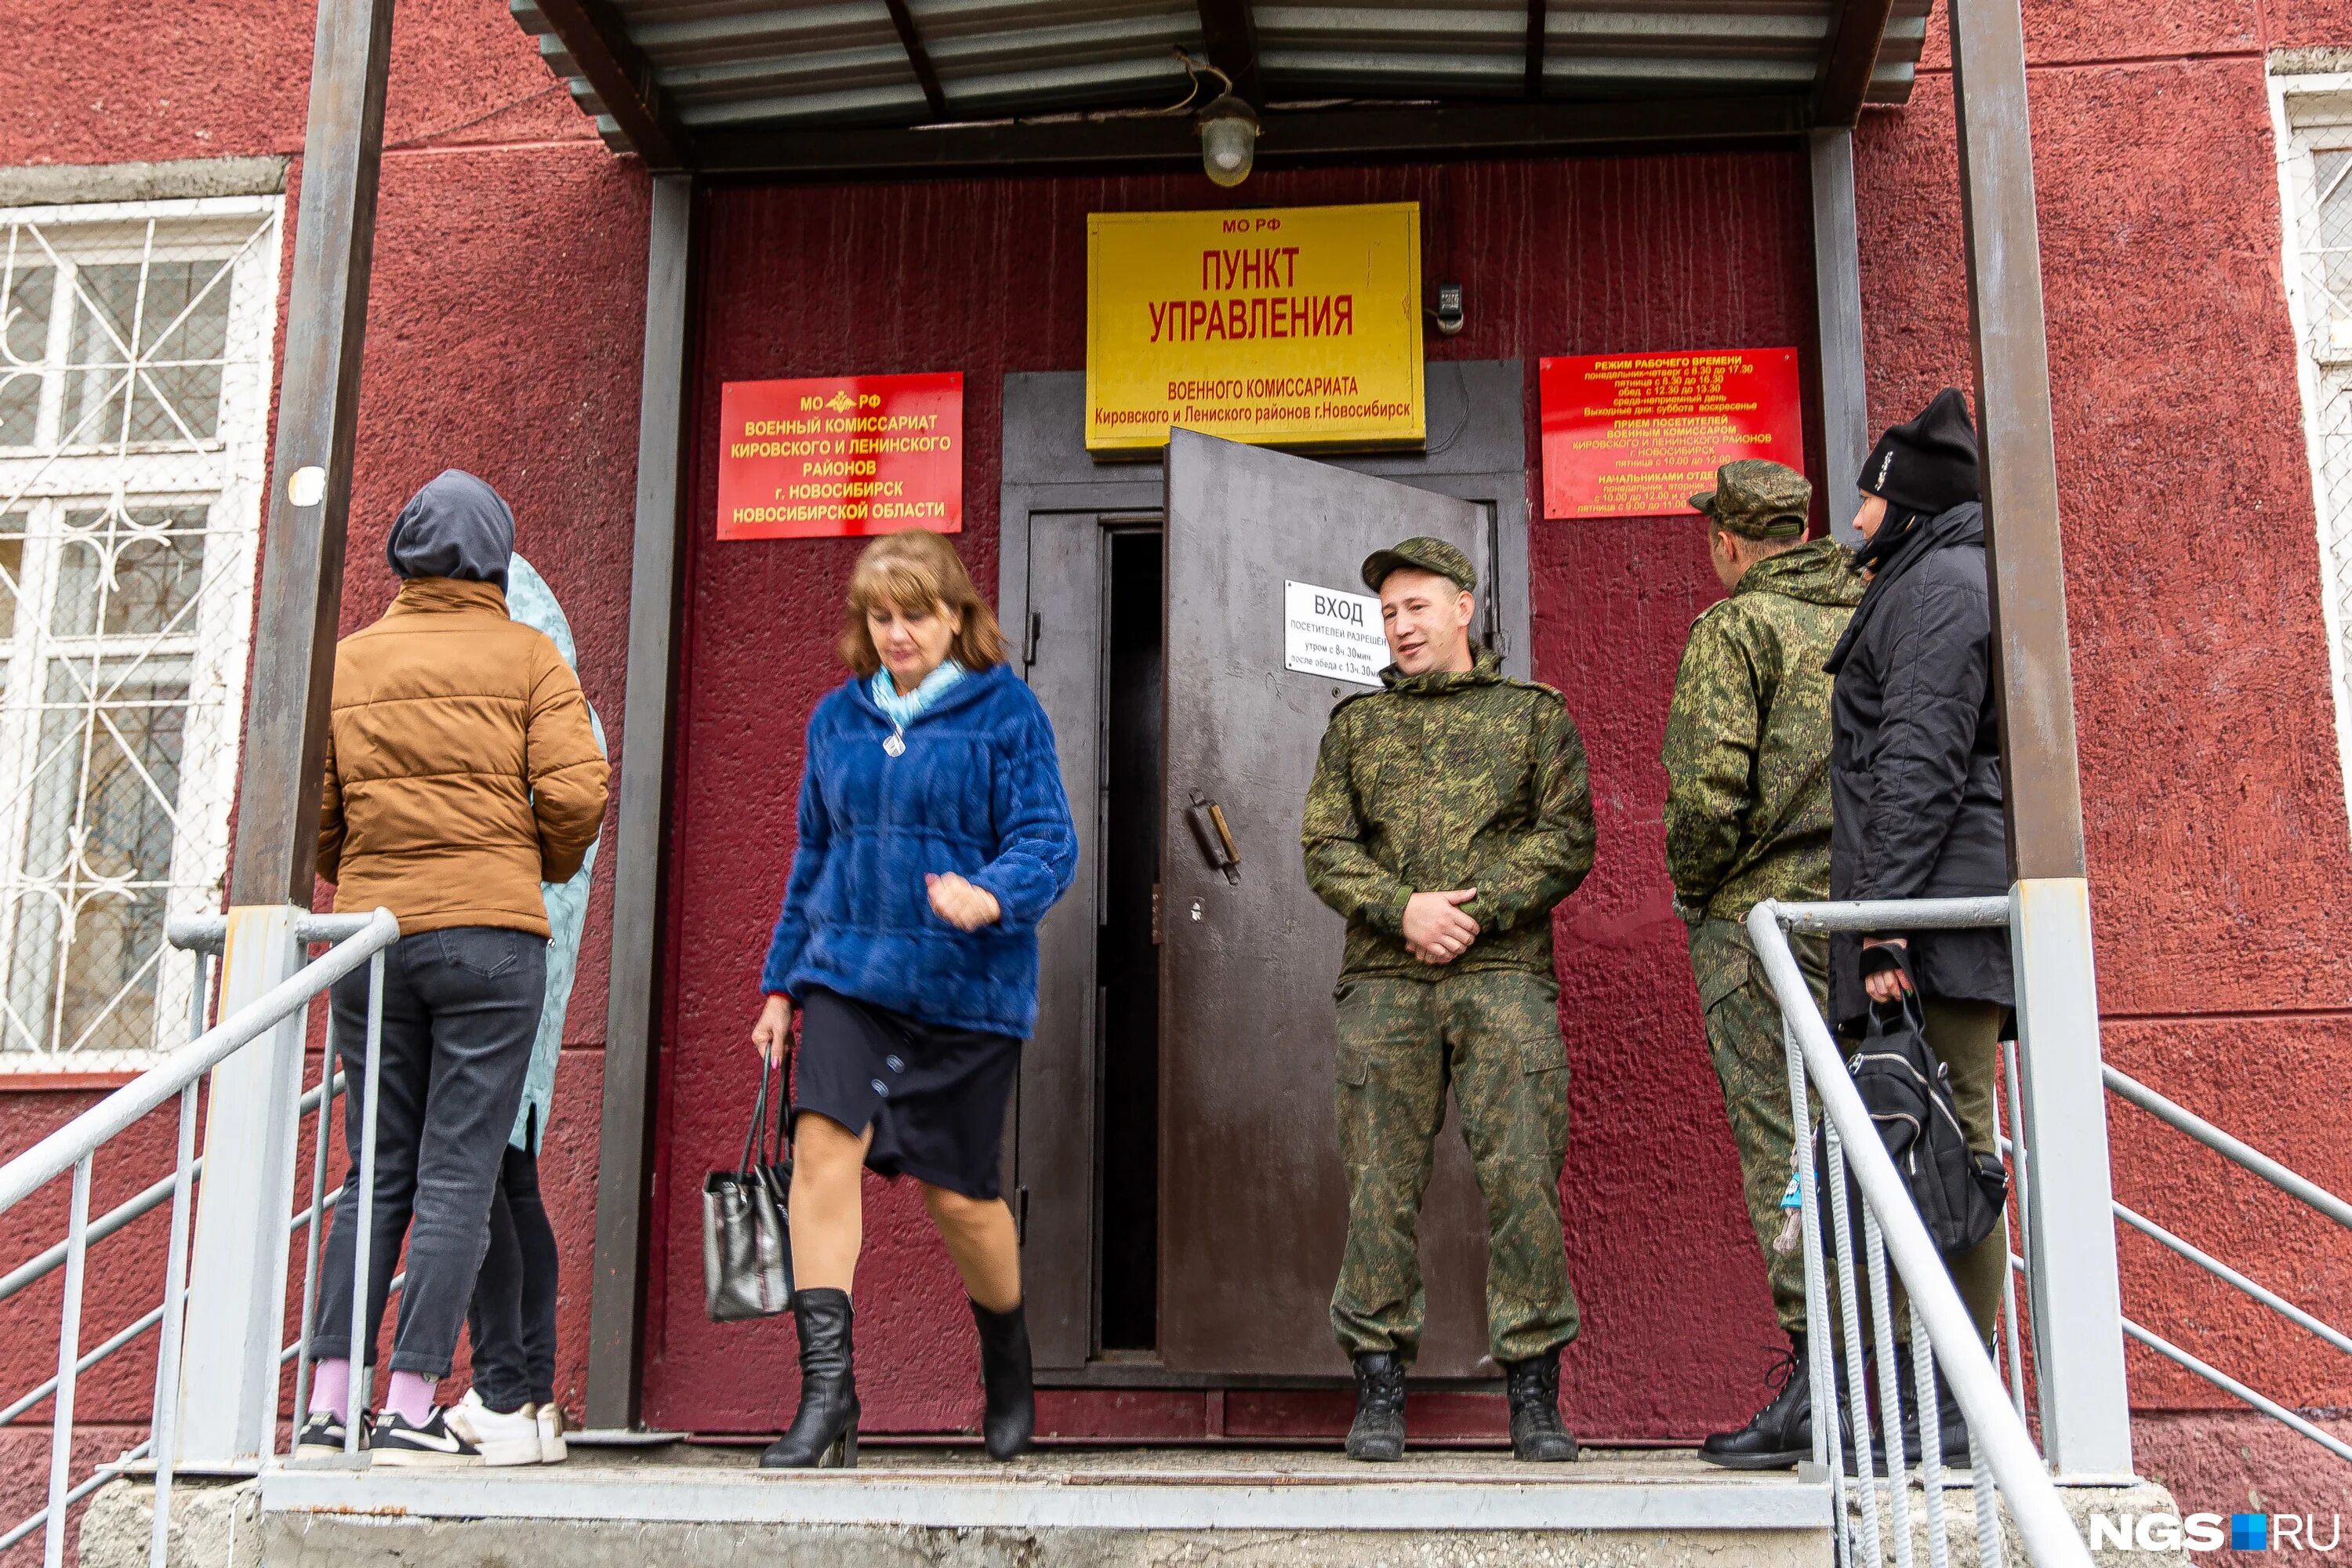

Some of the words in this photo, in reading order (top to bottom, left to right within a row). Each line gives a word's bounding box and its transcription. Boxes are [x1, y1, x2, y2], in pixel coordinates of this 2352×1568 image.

[1222, 220, 1249, 234] МО
[1256, 218, 1281, 232] РФ
[1203, 247, 1300, 291] ПУНКТ
[1149, 295, 1352, 343] УПРАВЛЕНИЯ
[1595, 361, 1632, 371] РЕЖИМ
[1635, 358, 1690, 369] РАБОЧЕГО
[1693, 356, 1742, 366] ВРЕМЕНИ
[1714, 367, 1725, 376] до
[1168, 379, 1243, 401] ВОЕННОГО
[1247, 376, 1358, 399] КОМИССАРИАТА
[1615, 379, 1652, 388] пятница
[1684, 376, 1696, 386] до
[1681, 386, 1693, 395] до
[800, 396, 823, 412] МО
[858, 394, 880, 409] РФ
[1704, 394, 1726, 404] день
[1095, 407, 1169, 427] Кировского
[1174, 412, 1180, 423] и
[1255, 403, 1310, 425] районов
[1584, 407, 1632, 417] Выходные
[1657, 403, 1693, 416] суббота
[1699, 402, 1757, 412] воскресенье
[745, 416, 821, 437] ВОЕННЫЙ
[826, 414, 938, 433] КОМИССАРИАТ
[1613, 419, 1650, 430] ПРИЕМ
[1653, 416, 1728, 427] ПОСЕТИТЕЛЕЙ
[1606, 429, 1661, 439] ВОЕННЫМ
[1663, 426, 1737, 435] КОМИССАРОМ
[731, 440, 831, 459] КИРОВСКОГО
[835, 439, 844, 455] И
[849, 436, 951, 454] ЛЕНИНСКОГО
[1573, 439, 1639, 451] КИРОВСКОГО
[1642, 438, 1649, 447] И
[1652, 436, 1719, 446] ЛЕНИНСКОГО
[1722, 434, 1772, 444] РАЙОНОВ
[1638, 445, 1715, 457] НОВОСИБИРСК
[803, 459, 877, 477] РАЙОНОВ
[1615, 458, 1653, 468] пятница
[1691, 456, 1703, 465] до
[1599, 472, 1683, 484] НАЧАЛЬНИКАМИ
[775, 487, 785, 500] г.
[789, 481, 903, 499] НОВОСИБИРСК
[1629, 494, 1641, 503] до
[734, 502, 868, 524] НОВОСИБИРСКОЙ
[872, 502, 945, 519] ОБЛАСТИ
[1577, 503, 1615, 513] пятница
[1648, 502, 1660, 510] до
[1315, 594, 1363, 627] ВХОД
[1290, 619, 1345, 638] ПОСЕТИТЕЛЕЙ
[1347, 631, 1386, 646] РАЗРЕШЕН
[1305, 642, 1327, 652] утром
[1291, 655, 1312, 665] после
[1316, 659, 1336, 670] обеда
